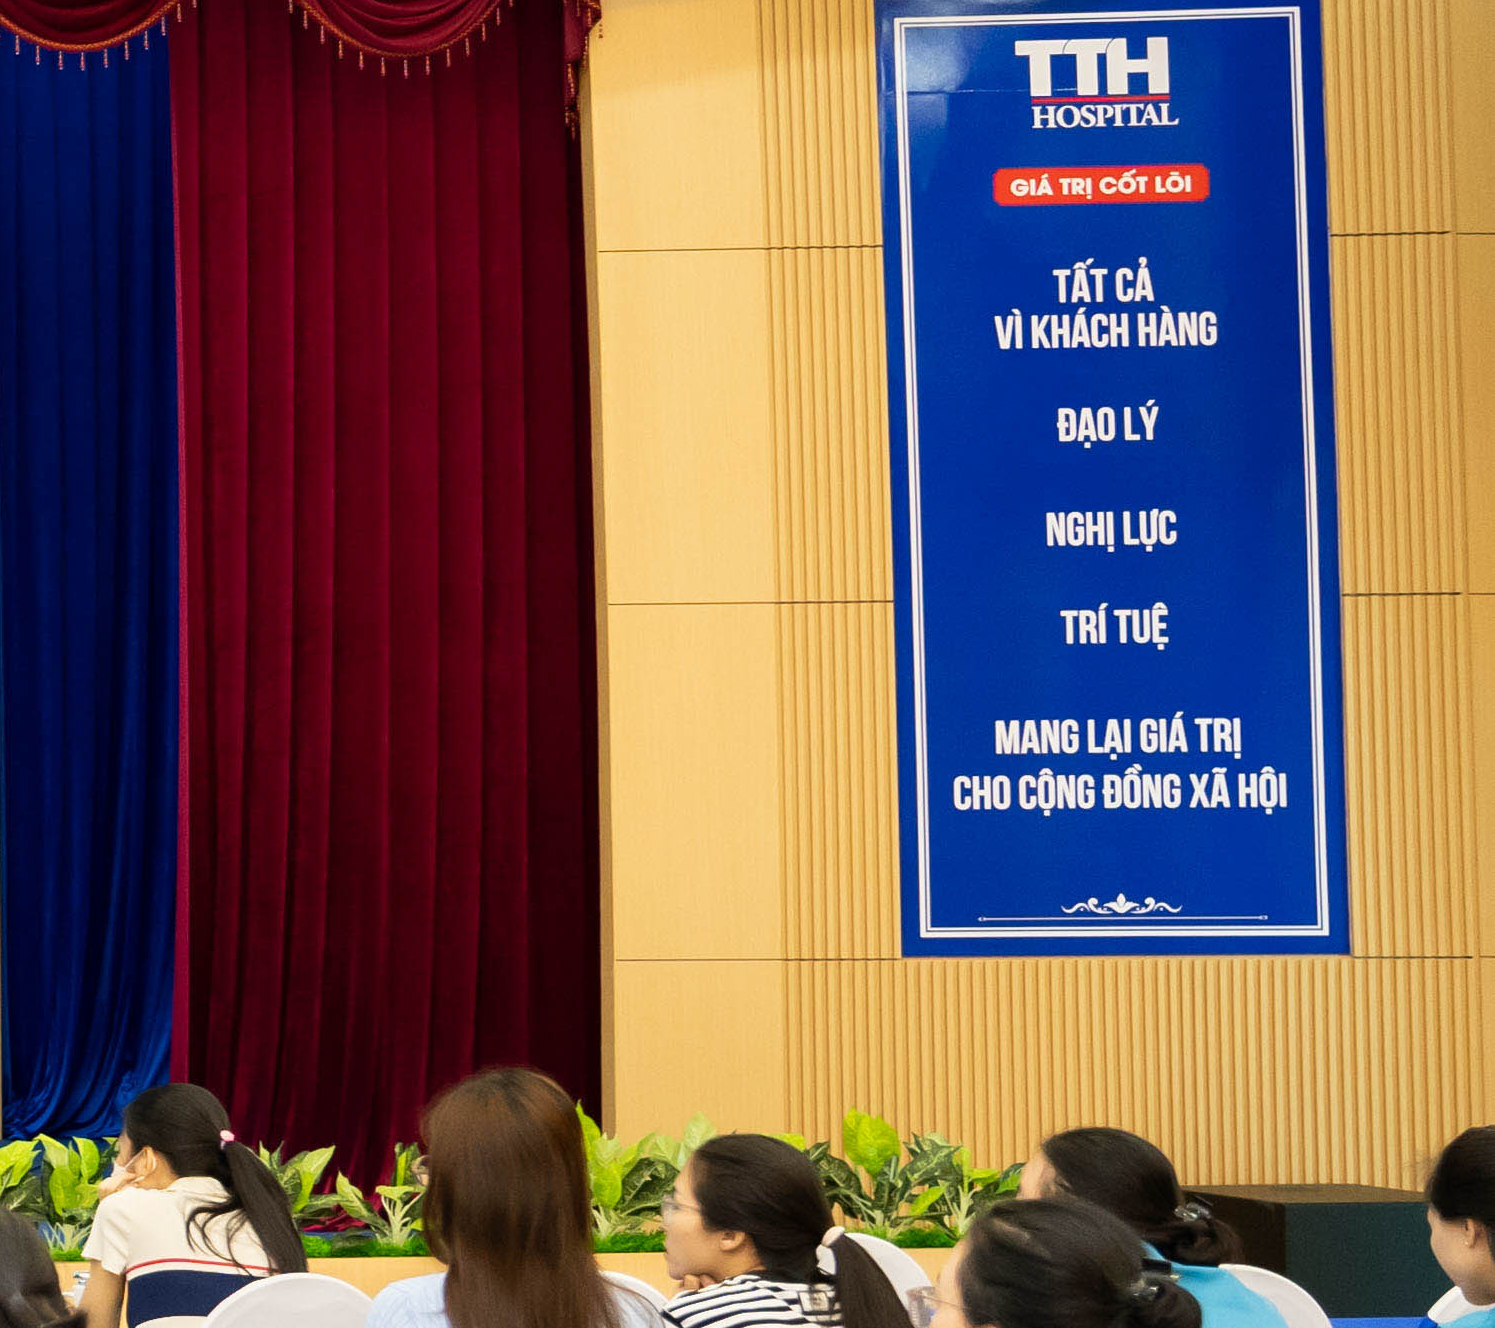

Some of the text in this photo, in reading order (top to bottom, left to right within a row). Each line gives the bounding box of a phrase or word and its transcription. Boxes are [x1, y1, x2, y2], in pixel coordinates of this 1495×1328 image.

[1014, 36, 1170, 97] TTH
[1031, 102, 1180, 129] HOSPITAL
[1010, 173, 1054, 197] GIÁ
[1058, 177, 1093, 200] TRỊ
[1098, 168, 1149, 195] CỐT
[1052, 256, 1155, 304] TẤT CẢ
[994, 305, 1218, 350] VÌ KHÁCH HÀNG
[1056, 399, 1159, 449] ĐẠO LÝ
[1045, 508, 1177, 553] NGHỊ LỰC
[1059, 601, 1169, 651] TRÍ TUỆ
[994, 711, 1242, 761] MANG LẠI GIÁ TRỊ
[953, 763, 1288, 817] CHO CỘNG ĐỒNG XÃ HỘI
